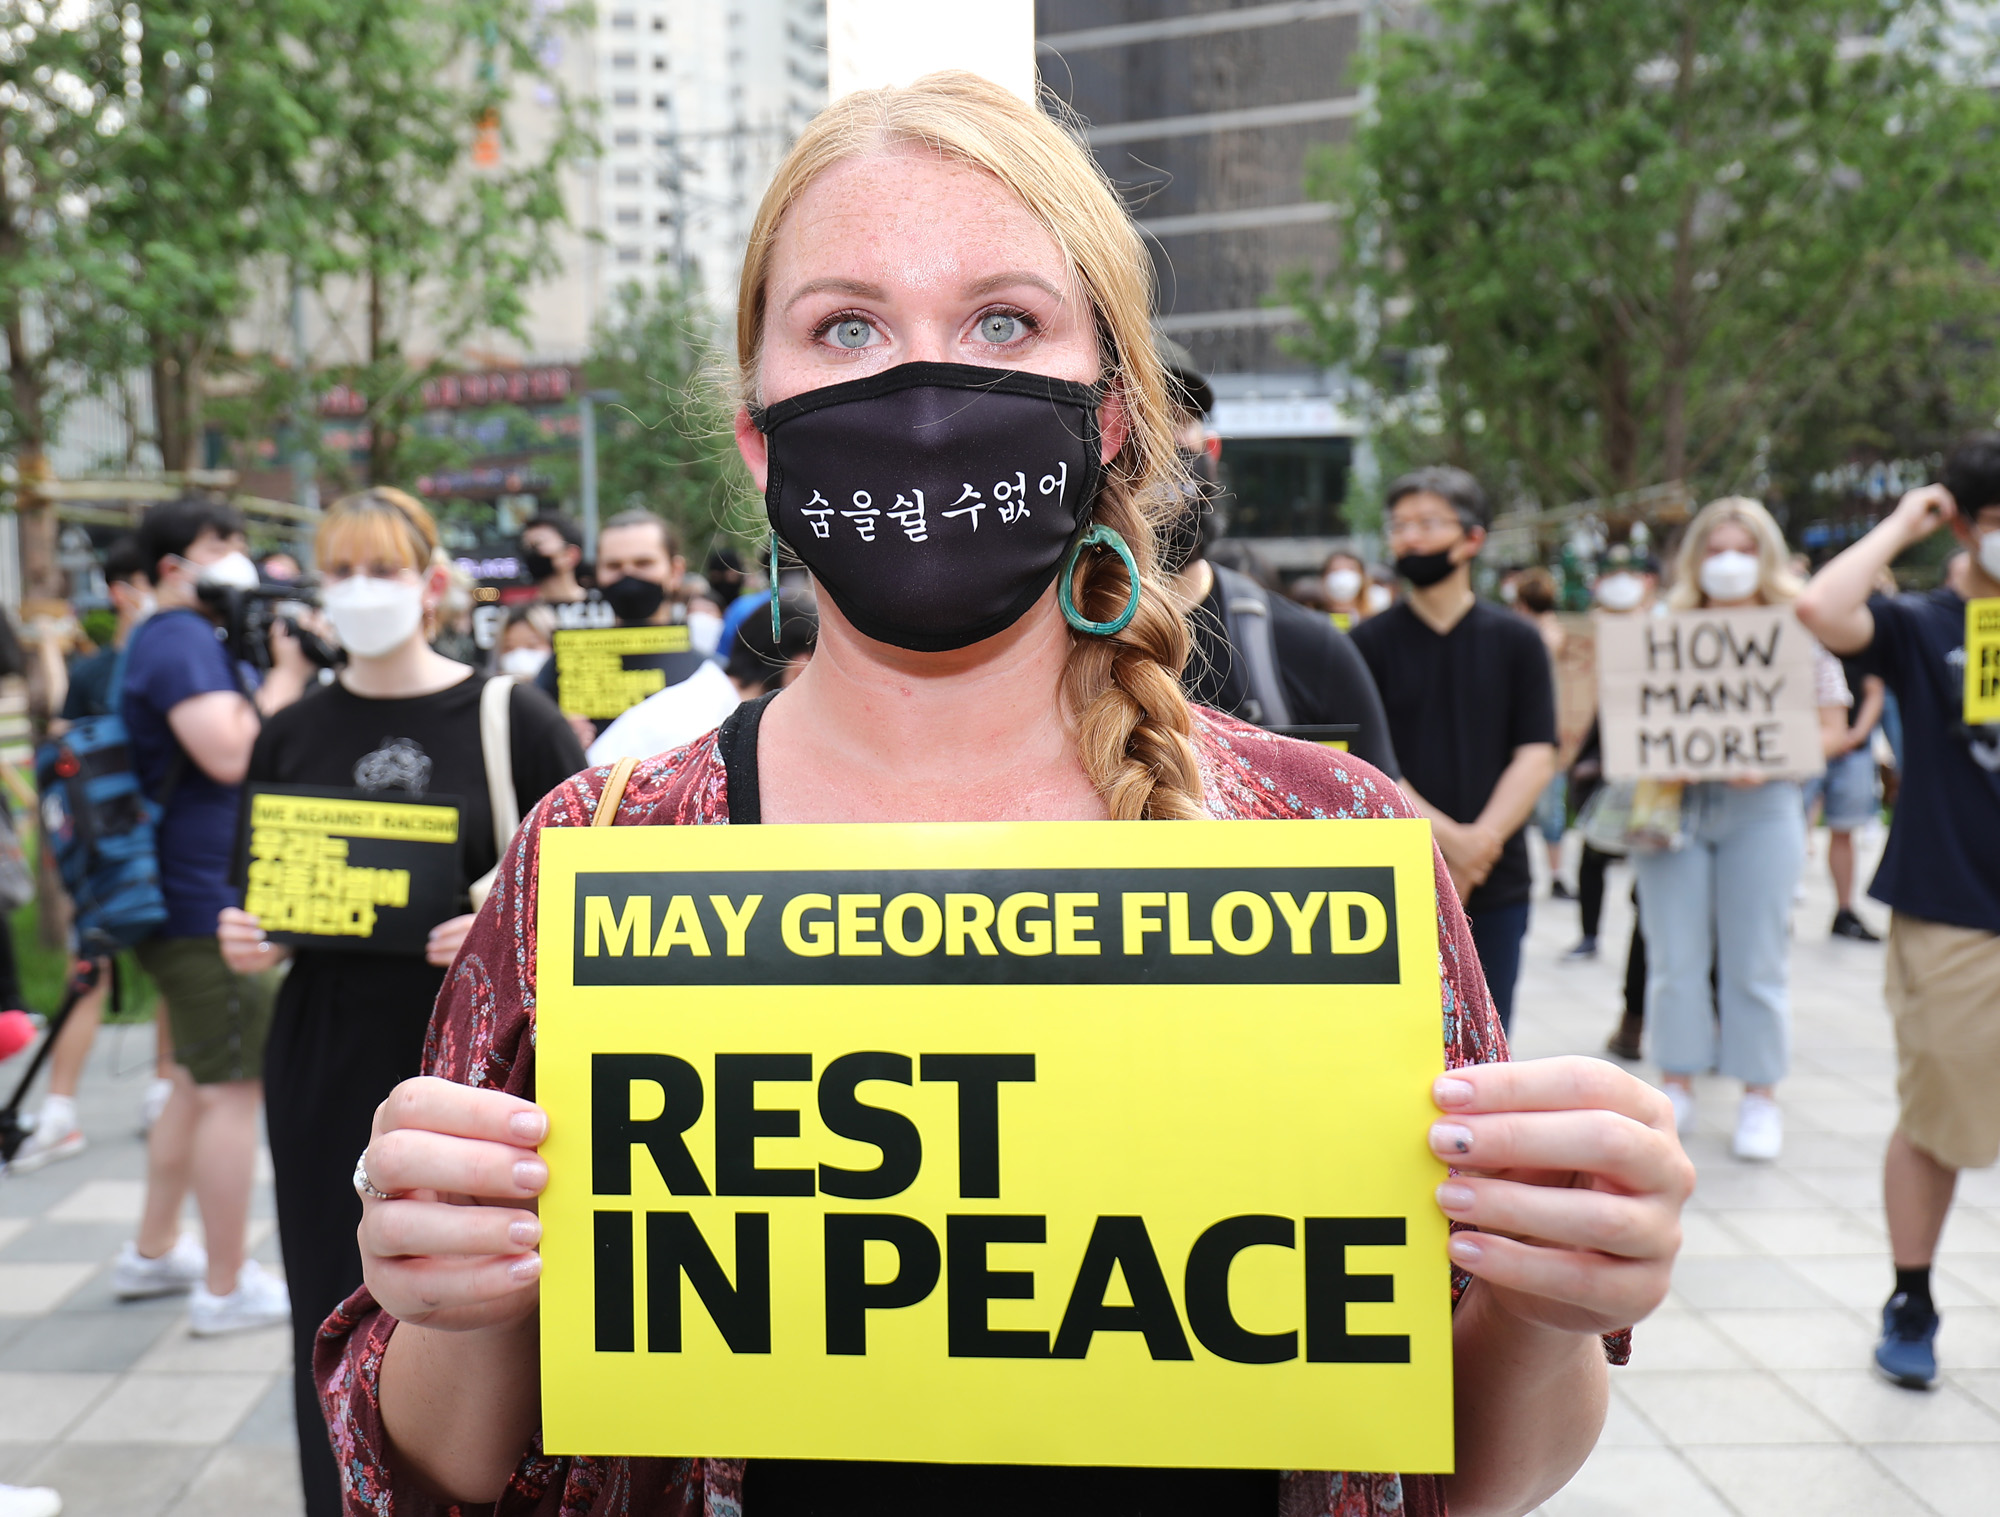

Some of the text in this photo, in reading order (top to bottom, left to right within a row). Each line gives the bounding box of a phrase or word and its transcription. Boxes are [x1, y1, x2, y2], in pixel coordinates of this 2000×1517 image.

[1645, 620, 1782, 672] HOW
[1640, 676, 1785, 716] MANY
[1637, 722, 1787, 769] MORE
[583, 891, 1388, 957] MAY GEORGE FLOYD
[592, 1051, 1036, 1200] REST
[593, 1210, 1412, 1365] IN PEACE
